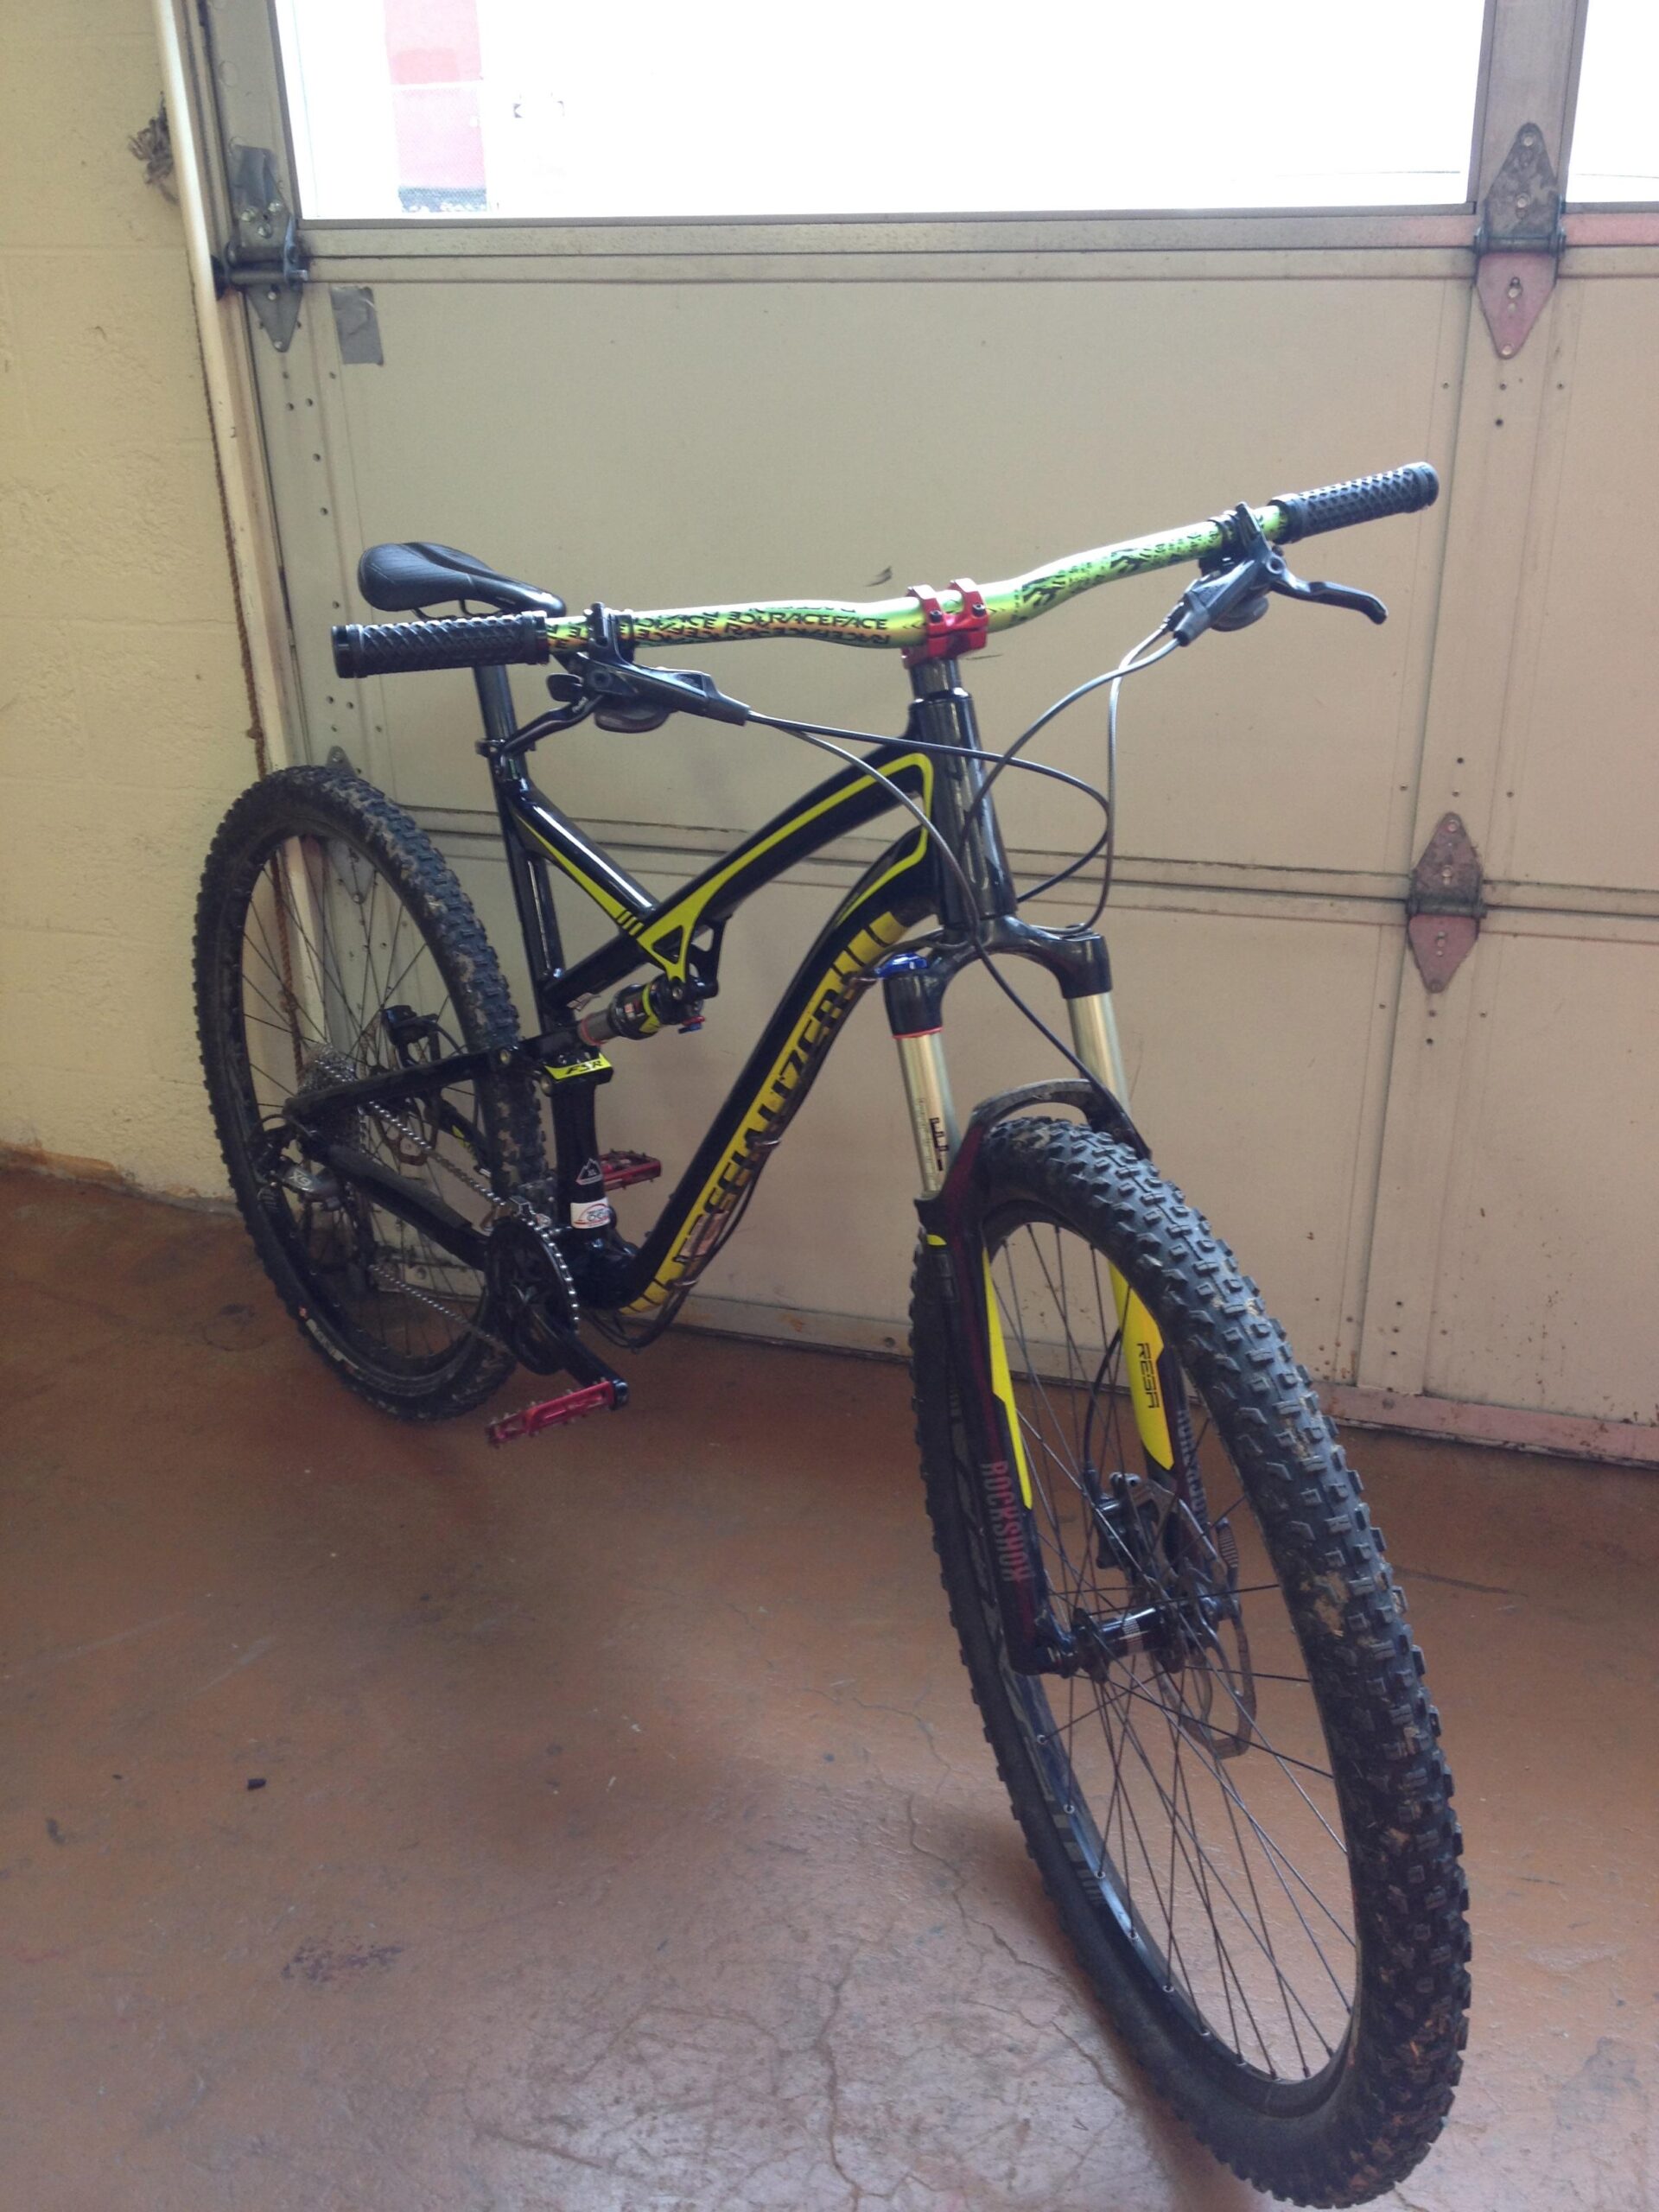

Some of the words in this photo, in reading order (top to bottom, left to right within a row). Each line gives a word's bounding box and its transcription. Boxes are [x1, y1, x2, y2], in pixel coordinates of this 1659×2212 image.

[768, 611, 888, 630] RACEFACE
[566, 1059, 603, 1074] FSR
[1137, 1342, 1160, 1408] REBA
[981, 1460, 1036, 1582] ROCKSHOX
